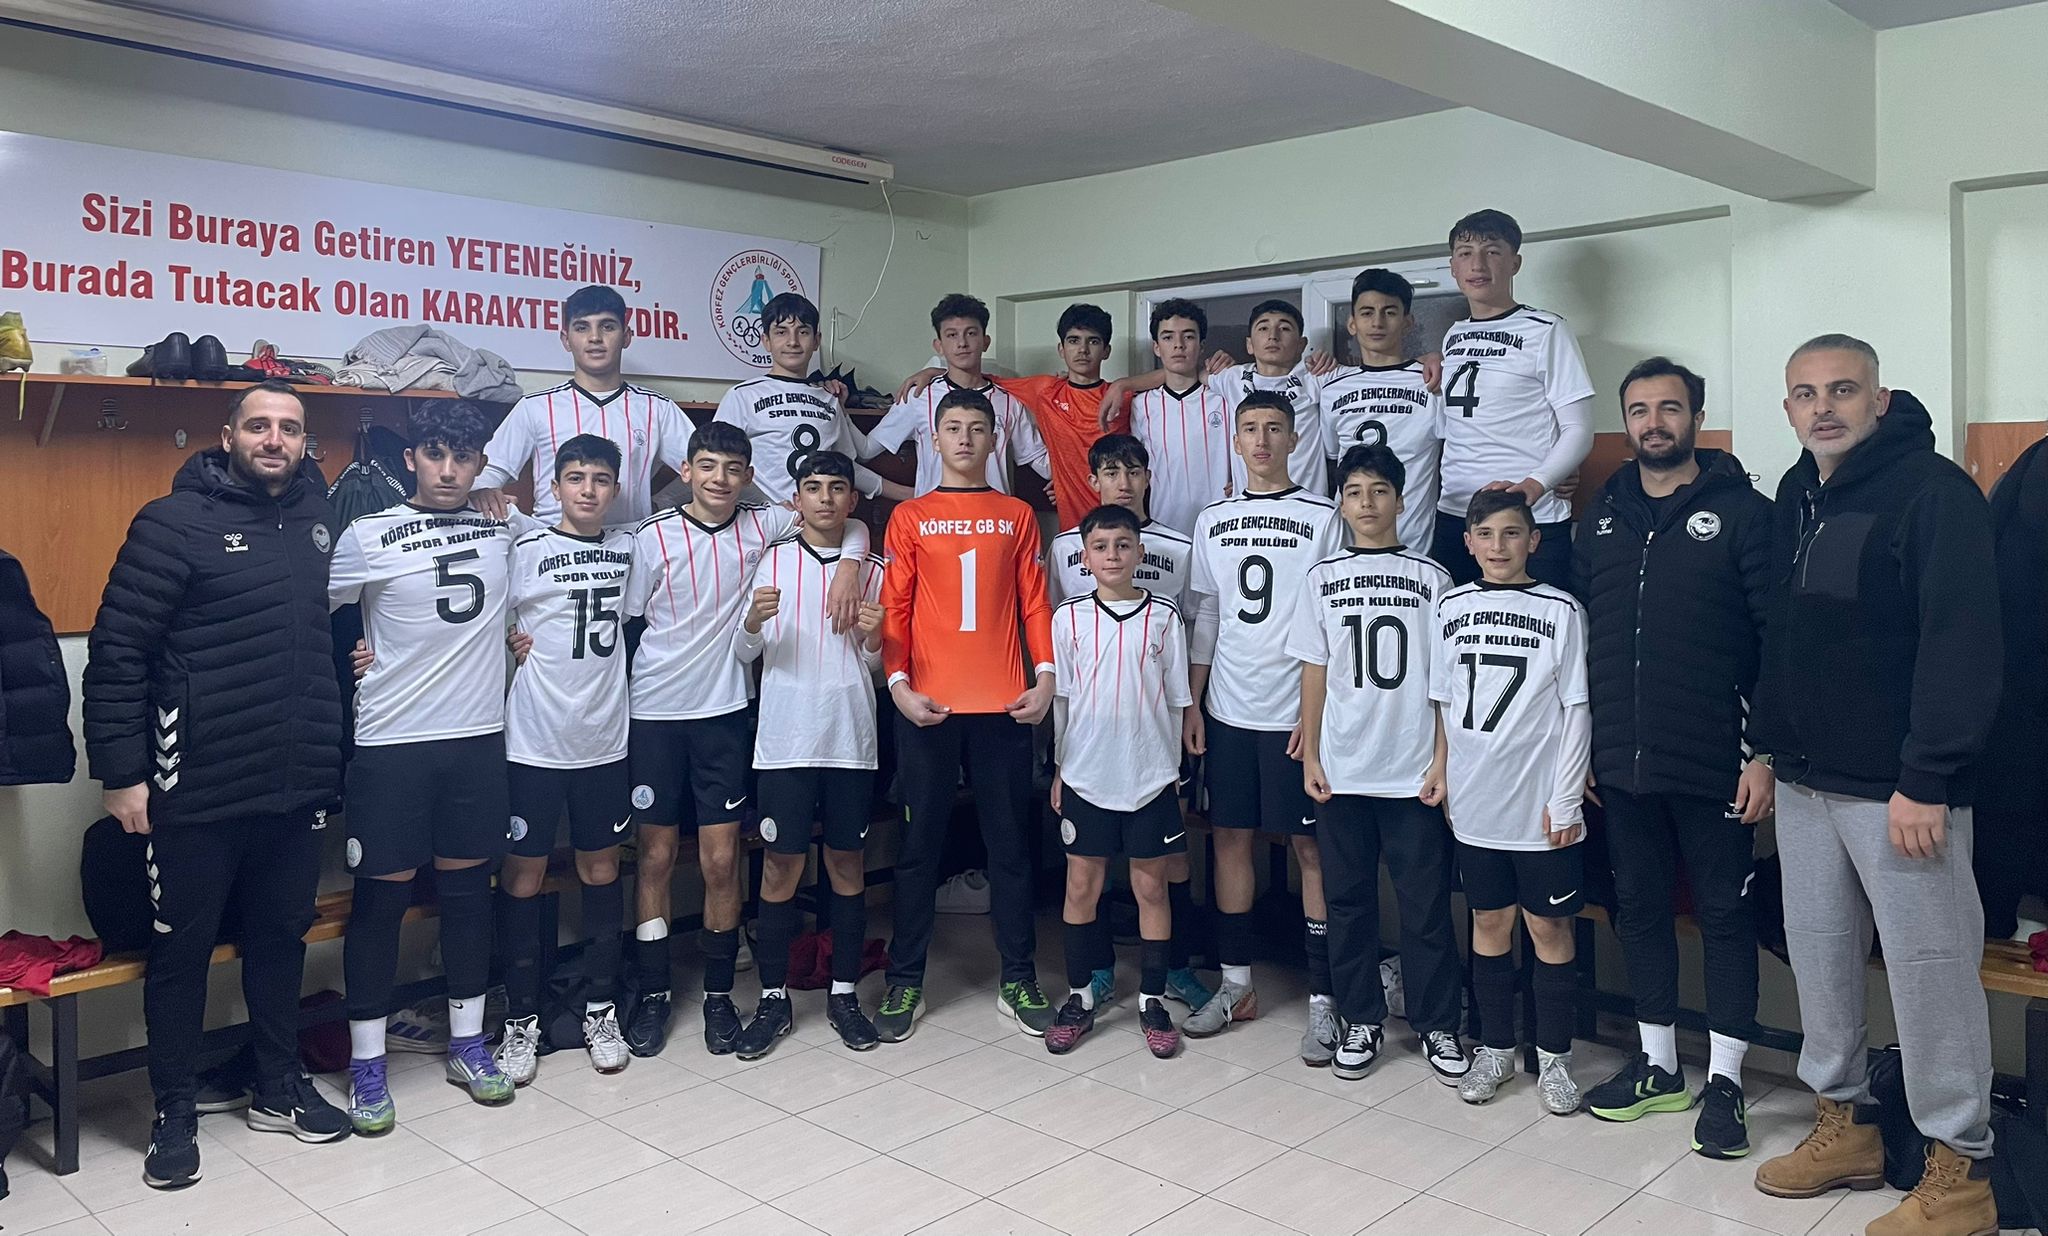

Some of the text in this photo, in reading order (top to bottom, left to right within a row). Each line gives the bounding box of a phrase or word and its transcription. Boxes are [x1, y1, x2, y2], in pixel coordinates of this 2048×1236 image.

[831, 155, 867, 168] CODEGEN
[82, 193, 642, 293] Sizi Buraya Getiren YETENEĞİNİZ,
[2, 249, 688, 341] Burada Tutacak Olan KARAKTEDİR.
[715, 253, 799, 329] KÖRFEZ GENÇLERBİRLİĞİ SPOR
[752, 354, 772, 364] 2015
[1331, 387, 1429, 412] KÖRFEZ GENÇLERBİRLİĞİ
[1445, 361, 1480, 417] 4
[753, 394, 784, 413] KÖRFEZ
[768, 410, 798, 418] SPOR
[1369, 404, 1413, 414] KULÜBÜ
[786, 423, 820, 480] 8
[380, 519, 423, 548] KÖRFEZ
[919, 518, 1014, 536] KÖRFEZ GB SK
[1209, 515, 1314, 541] KÖRFEZ GENÇLERBİRLİĞİ
[401, 538, 443, 553] SPOR
[1220, 536, 1298, 548] SPOR KULÜBÜ
[538, 553, 572, 577] KÖRFEZ
[553, 572, 589, 582] SPOR
[432, 549, 486, 624] 5
[958, 547, 977, 632] 1
[1237, 554, 1274, 624] 9
[1353, 575, 1432, 603] GENÇLERBİRLİĞİ
[1330, 595, 1420, 609] SPOR KULÜBÜ
[567, 586, 621, 660] 15
[1473, 611, 1556, 641] GENÇLERBİRLİĞİ
[1341, 614, 1409, 690] 10
[1454, 634, 1540, 649] SPOR KULÜBÜ
[1458, 652, 1528, 732] 17
